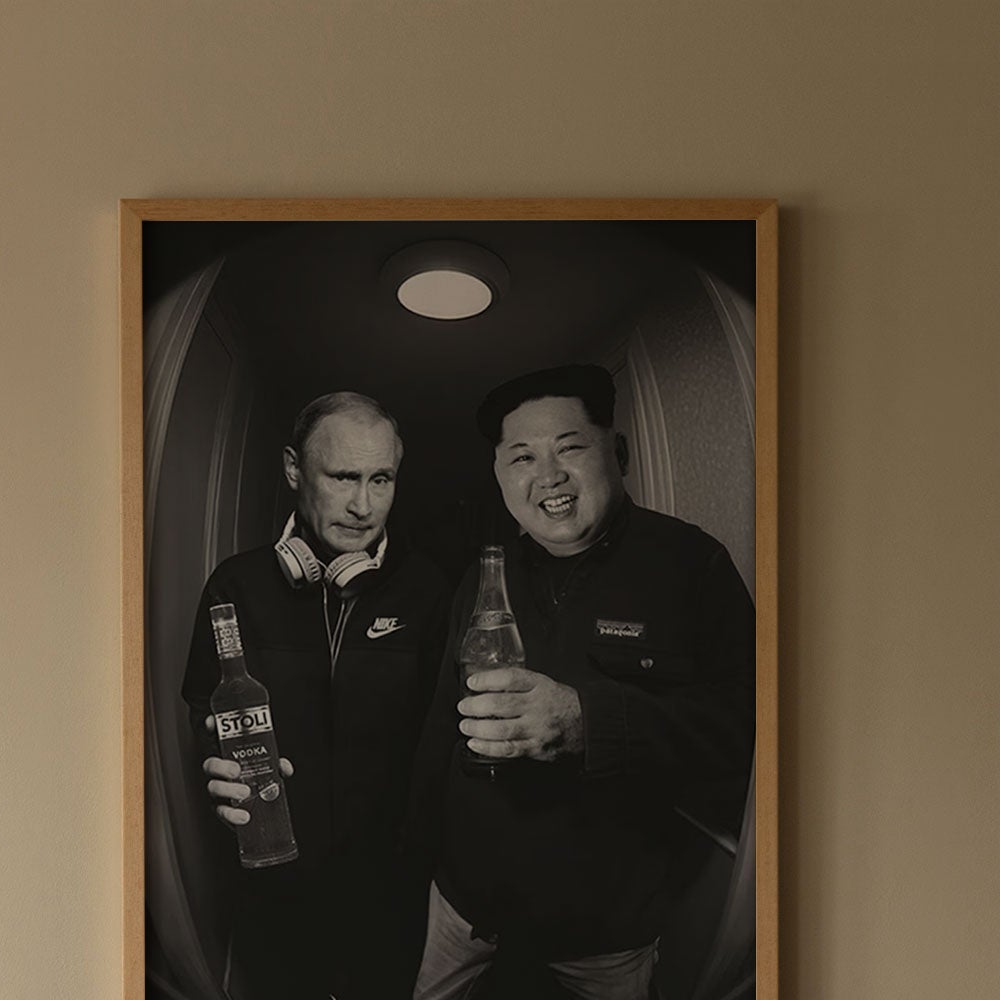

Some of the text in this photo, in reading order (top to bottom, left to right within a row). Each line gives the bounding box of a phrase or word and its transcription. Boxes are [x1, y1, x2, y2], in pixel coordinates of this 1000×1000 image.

[372, 617, 399, 631] NIKE
[221, 713, 267, 732] STOLI
[231, 745, 268, 759] VODKA
